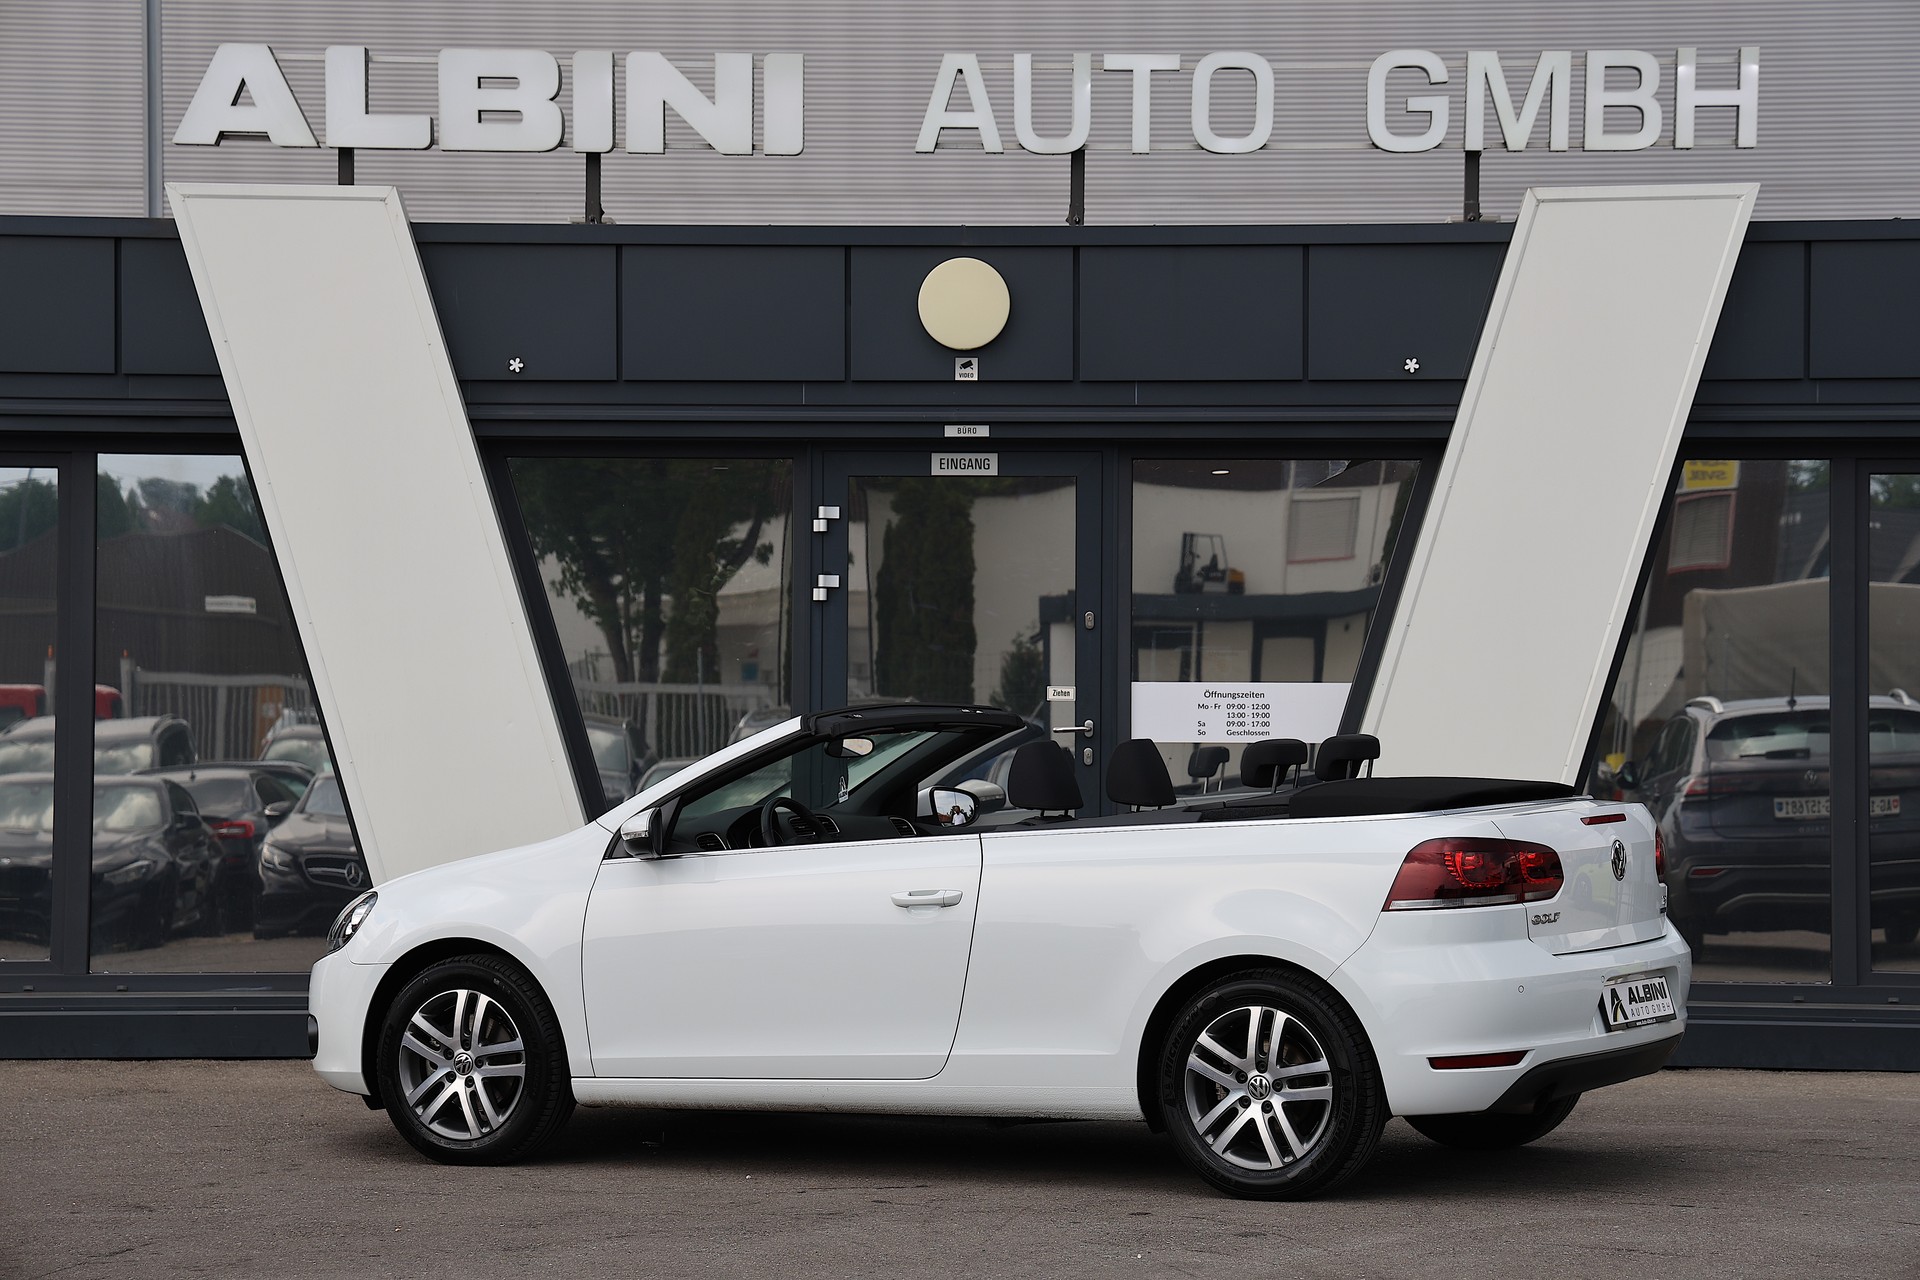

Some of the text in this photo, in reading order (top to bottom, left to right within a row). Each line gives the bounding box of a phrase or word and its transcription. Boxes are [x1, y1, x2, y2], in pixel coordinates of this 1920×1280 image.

[172, 42, 1760, 156] ALBINI AUTO GMBH
[957, 426, 977, 434] BÜRO
[939, 458, 990, 470] EINGANG
[1052, 689, 1071, 698] Ziehen
[1204, 689, 1265, 700] Öffnungszeiten
[1531, 912, 1560, 925] GOLF
[1628, 982, 1667, 1005] ALBINI
[1630, 1002, 1671, 1017] AUTO GMBH
